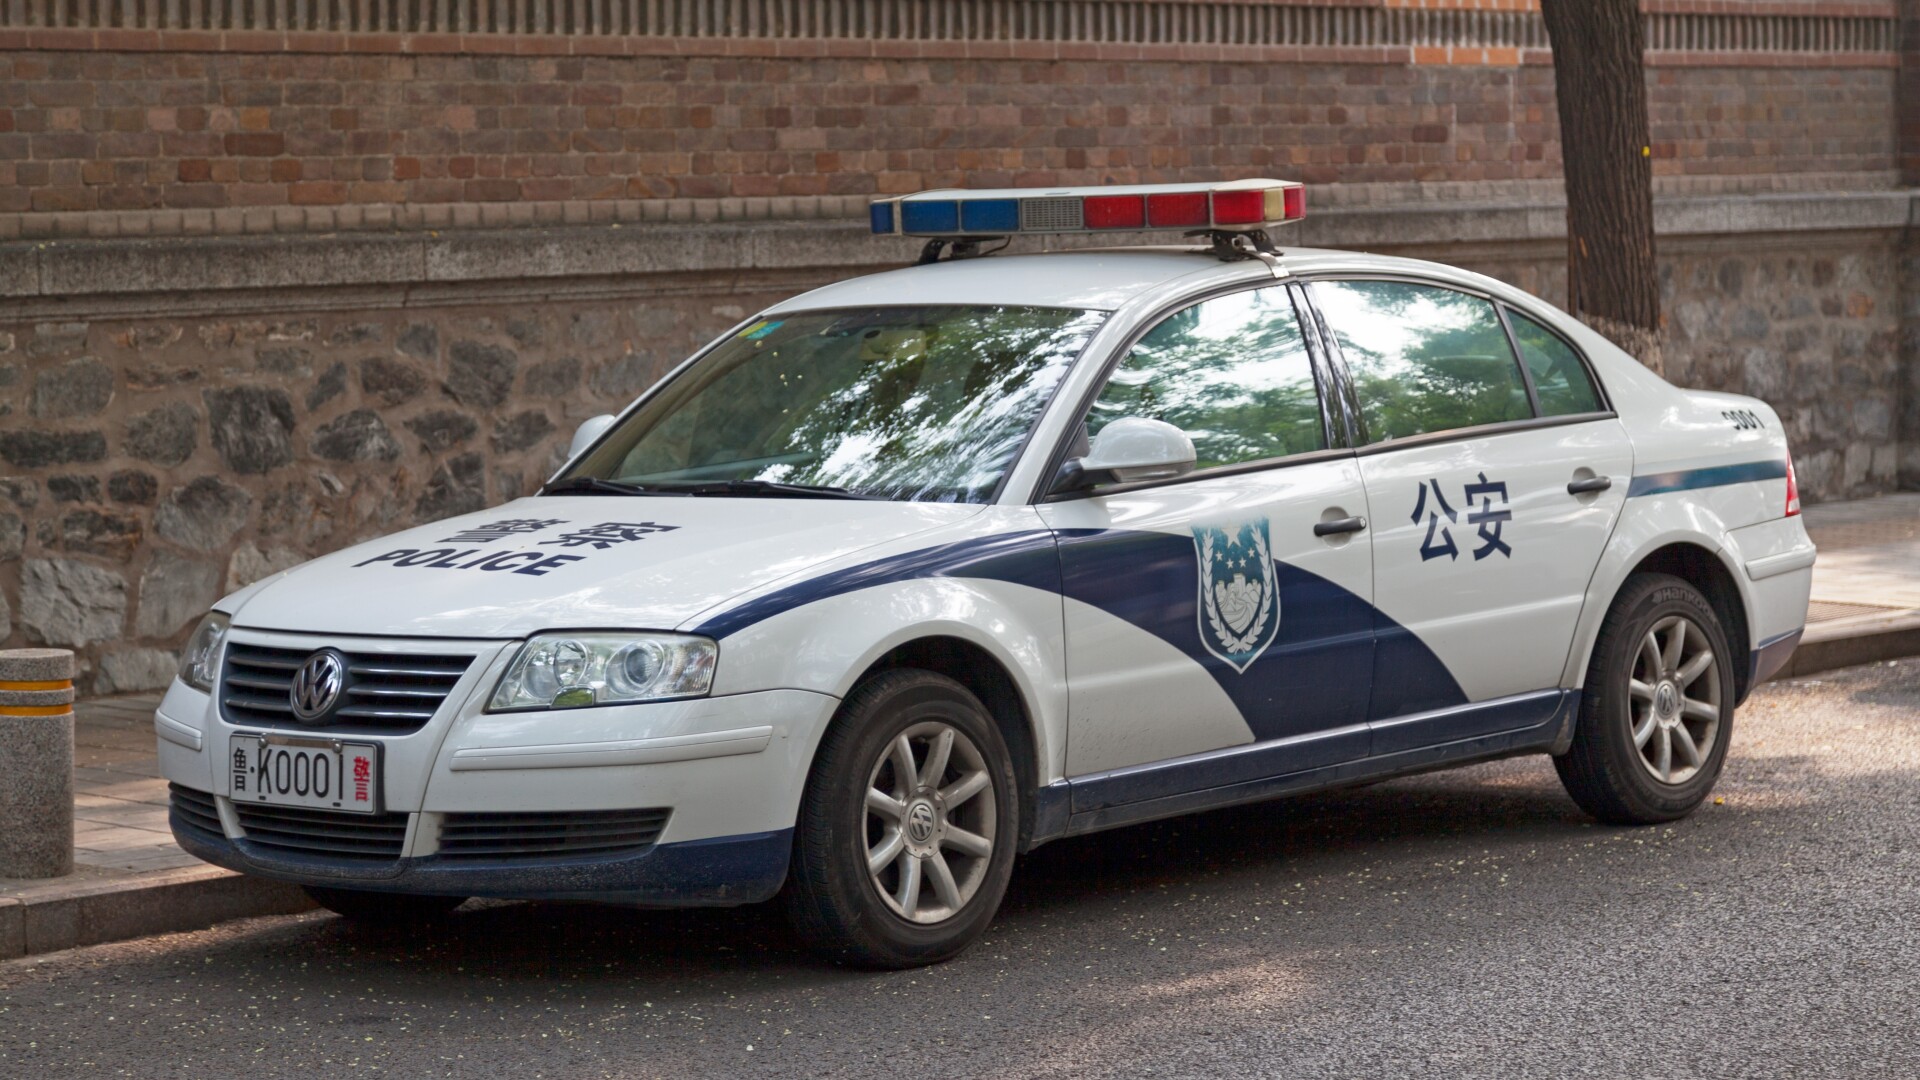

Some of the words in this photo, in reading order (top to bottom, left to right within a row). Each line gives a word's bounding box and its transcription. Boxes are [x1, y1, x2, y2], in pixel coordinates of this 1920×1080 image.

[1410, 471, 1512, 562] 公安
[435, 518, 682, 549] 警察
[350, 548, 588, 577] POLICE
